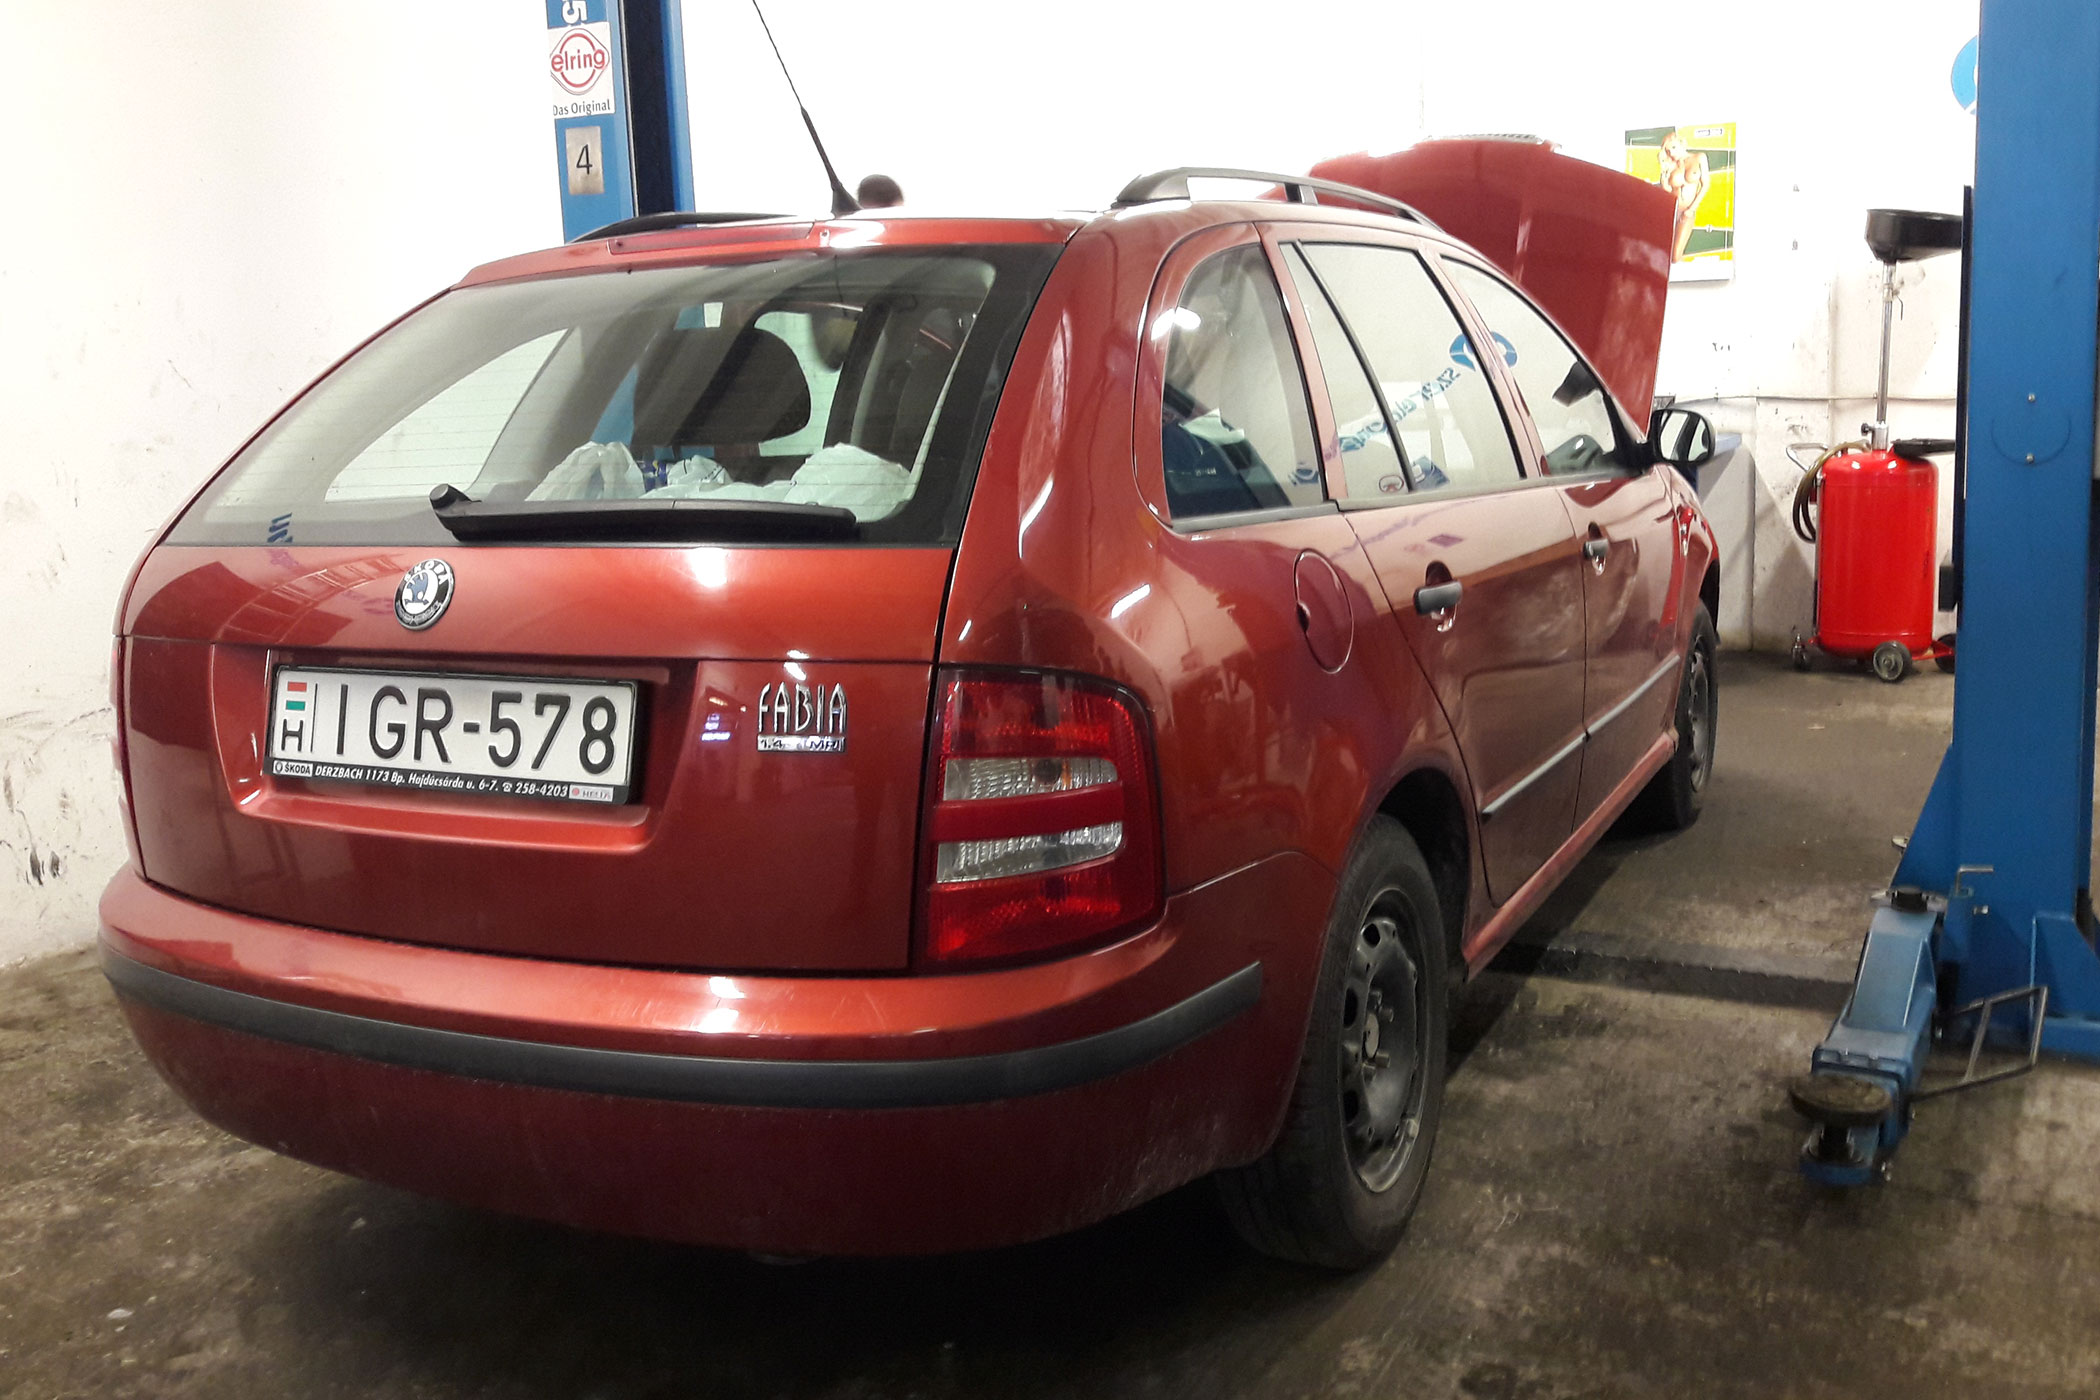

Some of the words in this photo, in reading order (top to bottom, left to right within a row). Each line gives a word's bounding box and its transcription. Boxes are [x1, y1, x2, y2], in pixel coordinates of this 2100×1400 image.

[551, 49, 606, 73] elring
[553, 104, 569, 117] Das
[571, 99, 611, 116] Original
[576, 144, 593, 175] 4
[758, 682, 848, 734] FABIA
[281, 719, 304, 752] H
[336, 684, 617, 775] IGR-578
[760, 738, 784, 749] 1.4
[315, 765, 364, 780] DERZBACH
[365, 769, 389, 782] 1173
[391, 771, 405, 786] Bp.
[466, 780, 475, 790] u.
[478, 779, 499, 792] 6-7.
[515, 782, 569, 798] 258-4203
